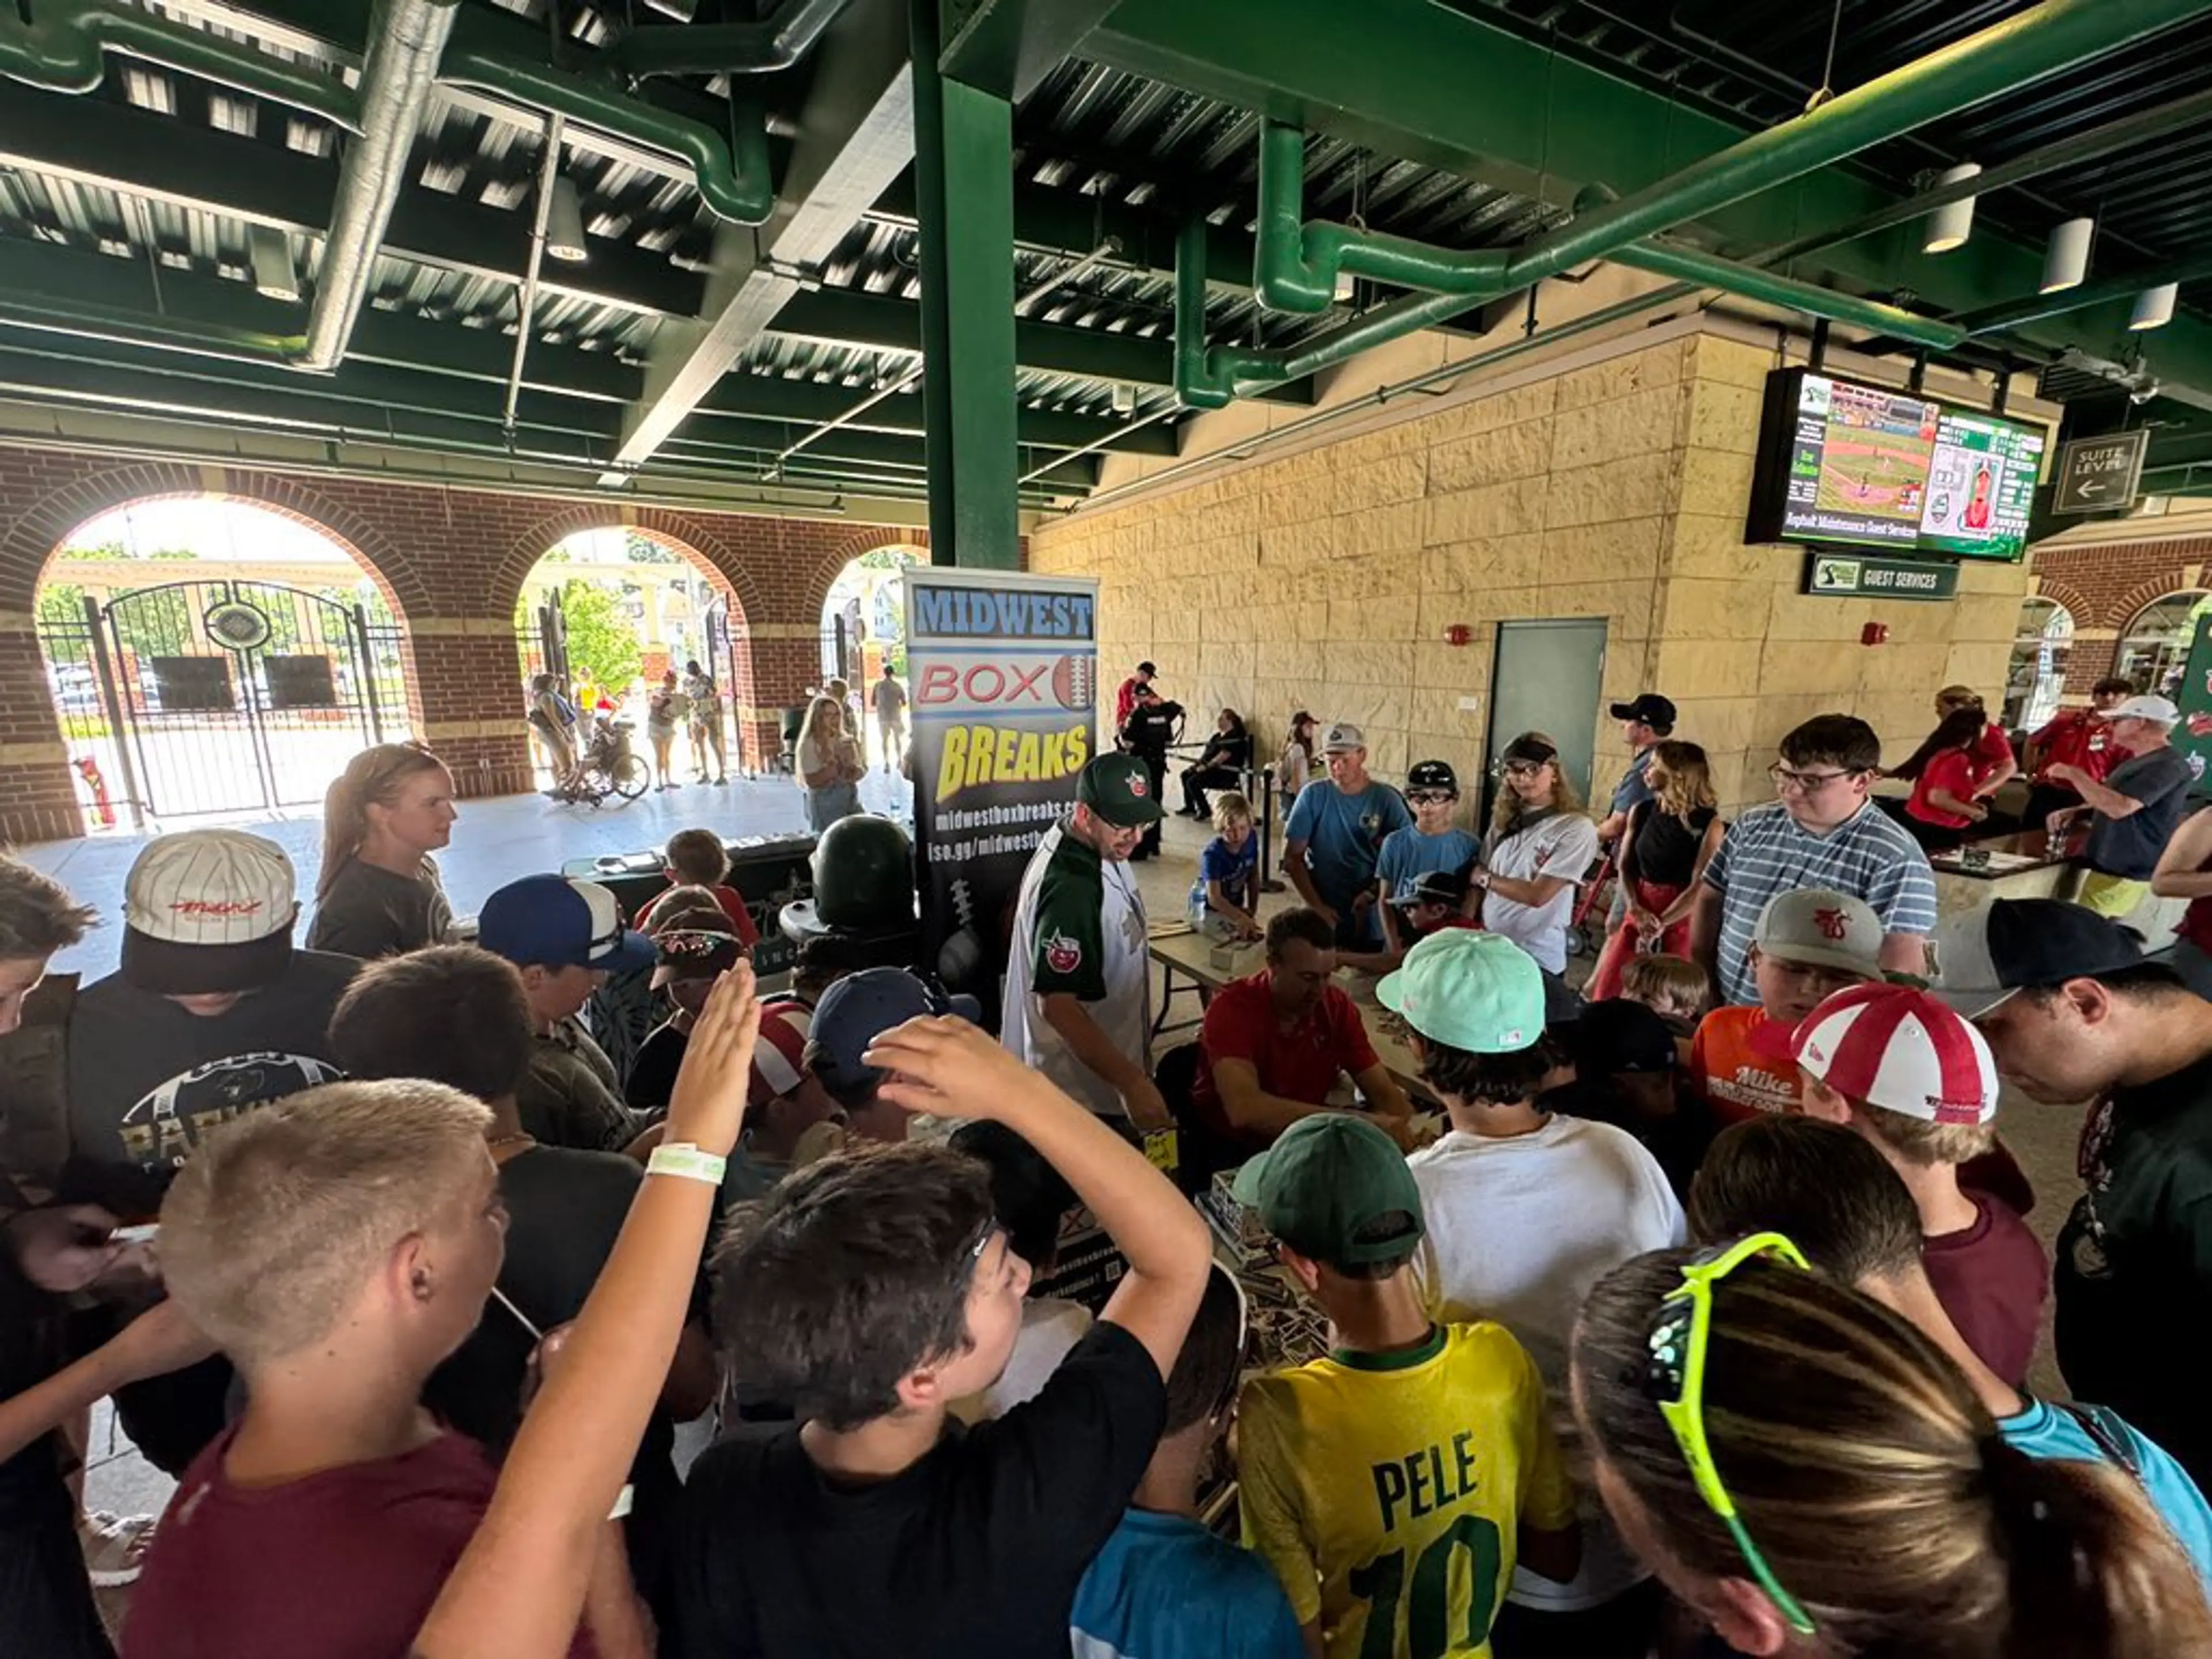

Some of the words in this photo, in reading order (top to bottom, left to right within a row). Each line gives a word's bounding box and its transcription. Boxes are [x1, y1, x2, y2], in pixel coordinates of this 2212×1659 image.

[2075, 459, 2124, 475] LEVEL
[2079, 446, 2125, 463] SUITE
[1863, 569, 1895, 586] GUEST
[1895, 570, 1937, 589] SERVICES
[915, 588, 1092, 637] MIDWEST
[915, 664, 1049, 703] BOX
[935, 724, 1088, 804] BREAKS
[1736, 1066, 1793, 1094] Mike
[1372, 1430, 1478, 1532] PELE
[1349, 1514, 1501, 1659] 10
